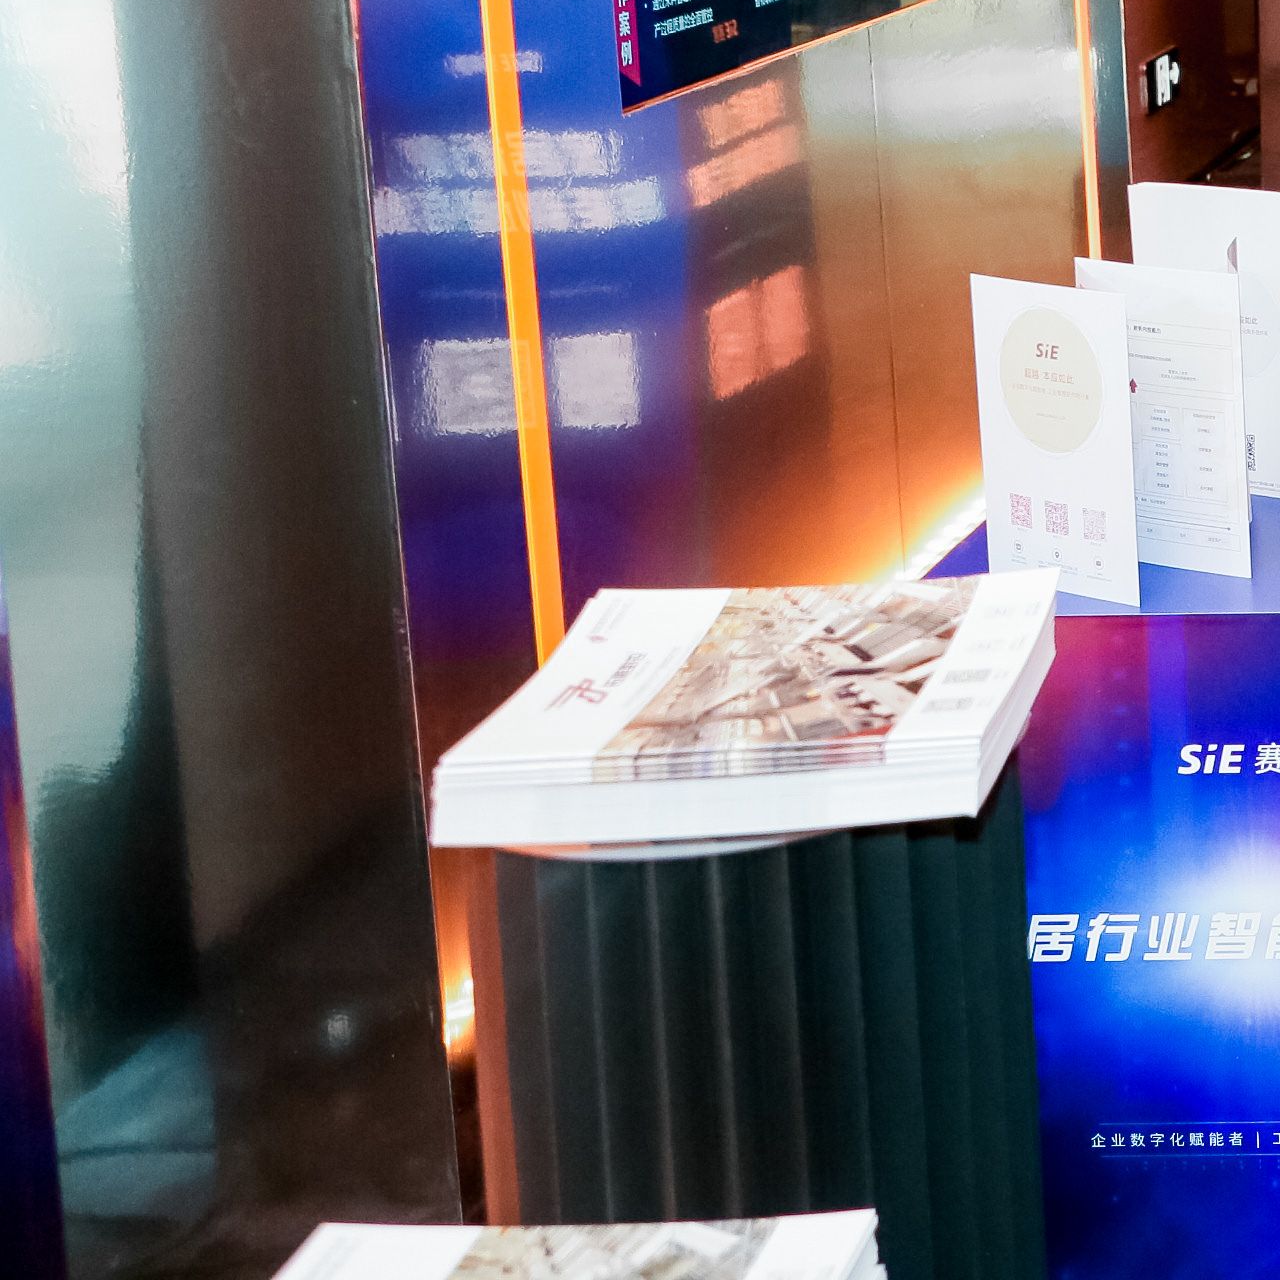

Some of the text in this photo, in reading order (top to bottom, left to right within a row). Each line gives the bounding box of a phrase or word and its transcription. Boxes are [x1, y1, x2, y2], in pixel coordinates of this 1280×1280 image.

[1035, 342, 1060, 360] SiE
[1177, 744, 1245, 774] SiE
[1090, 1131, 1245, 1148] 企业数字化赋能者
